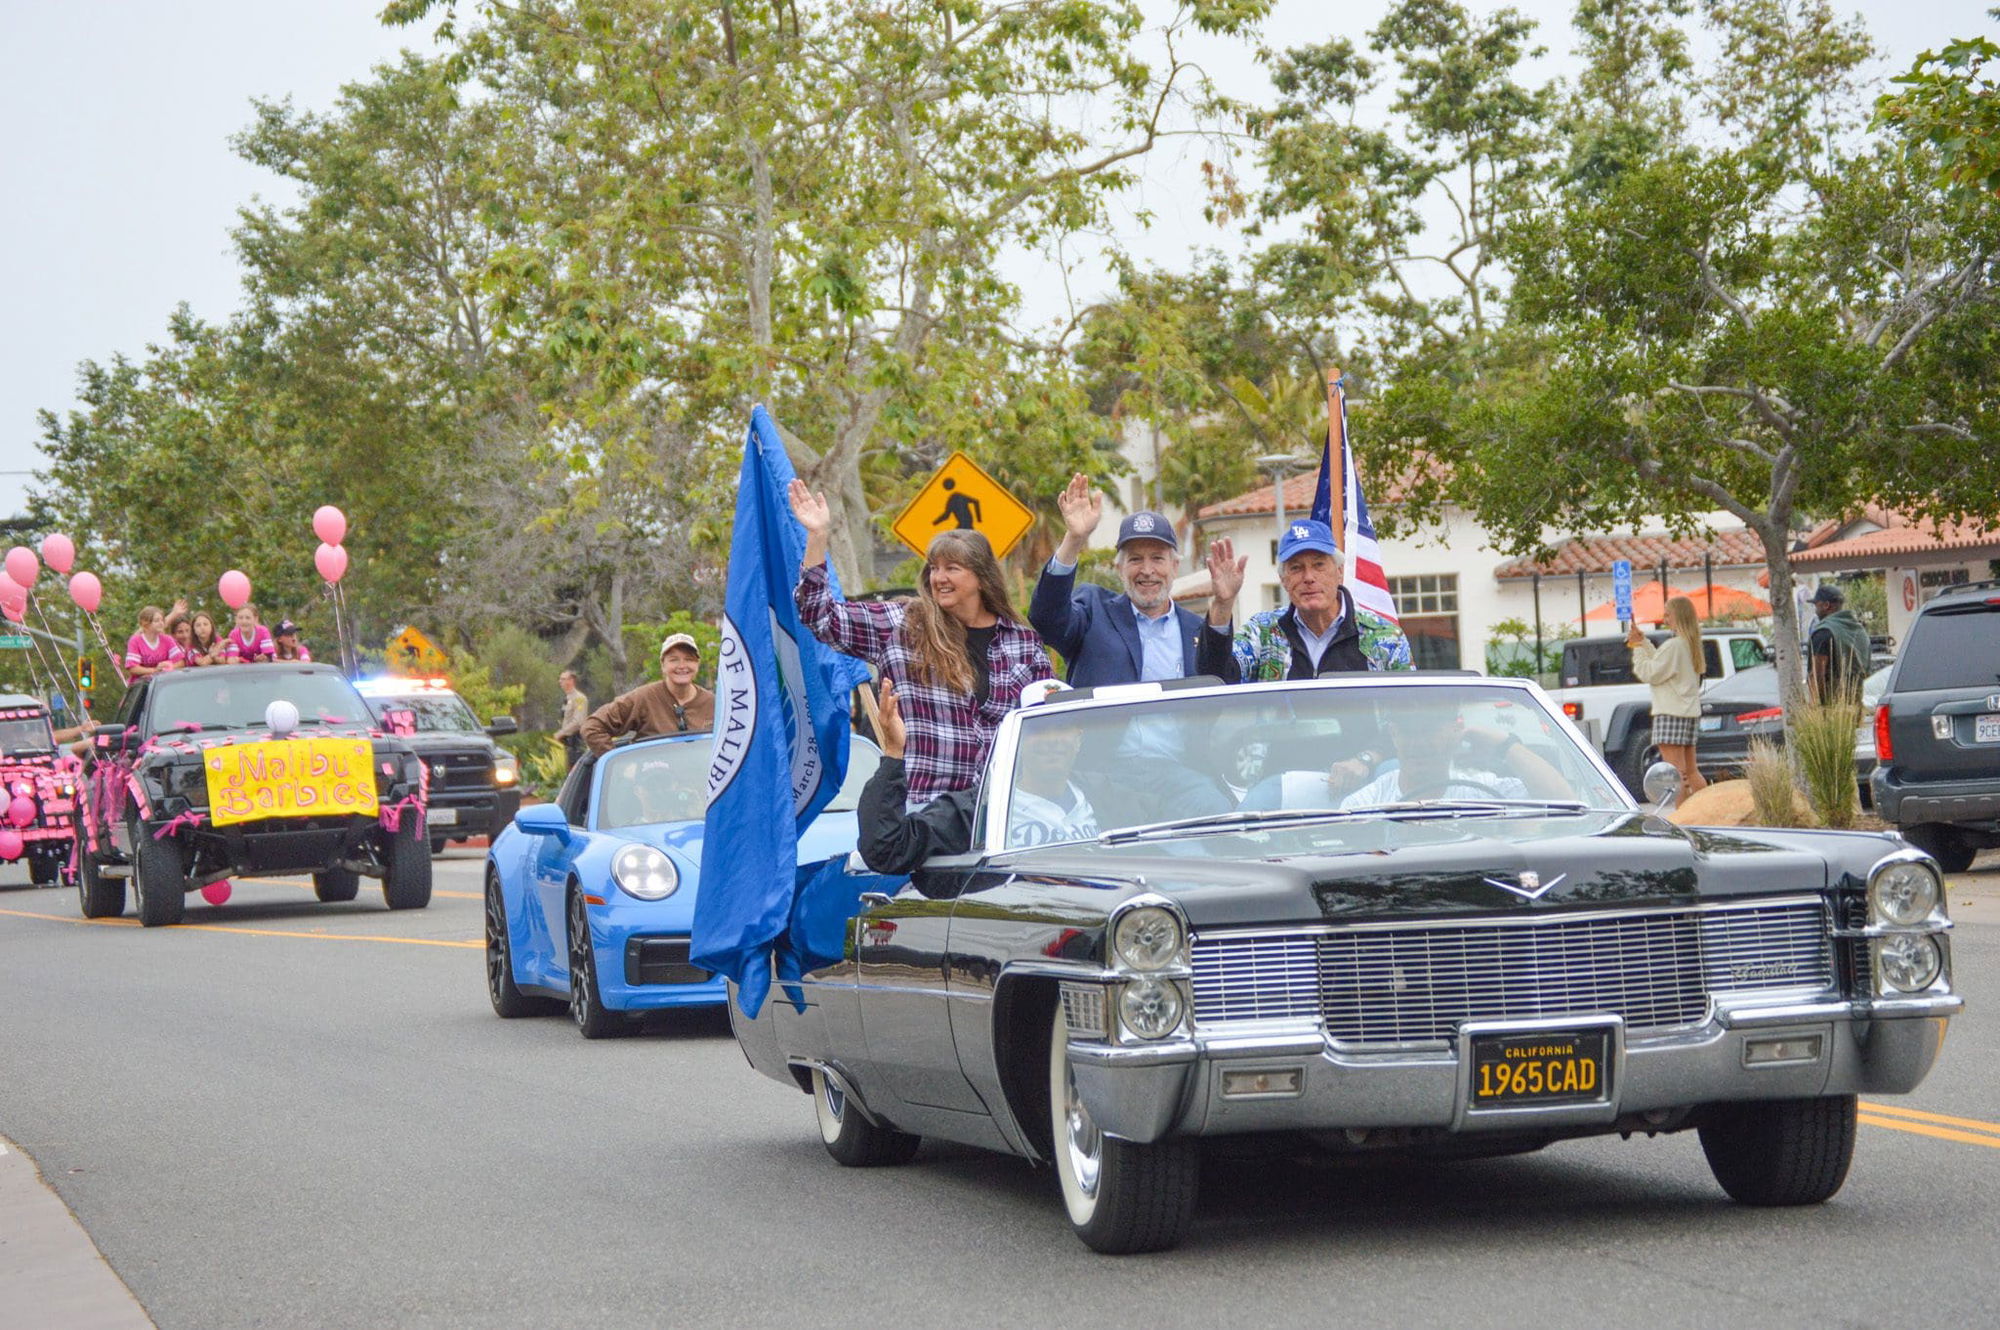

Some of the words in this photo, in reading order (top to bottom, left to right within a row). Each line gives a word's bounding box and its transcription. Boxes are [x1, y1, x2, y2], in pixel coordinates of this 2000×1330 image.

[1291, 525, 1310, 539] LA
[720, 637, 745, 674] OF
[706, 688, 750, 798] MALIB
[228, 742, 350, 788] Malibu
[793, 759, 817, 803] March
[215, 776, 376, 818] Barbies
[1505, 1044, 1574, 1059] CALIFORNIA
[1478, 1057, 1596, 1097] 1965CAD
